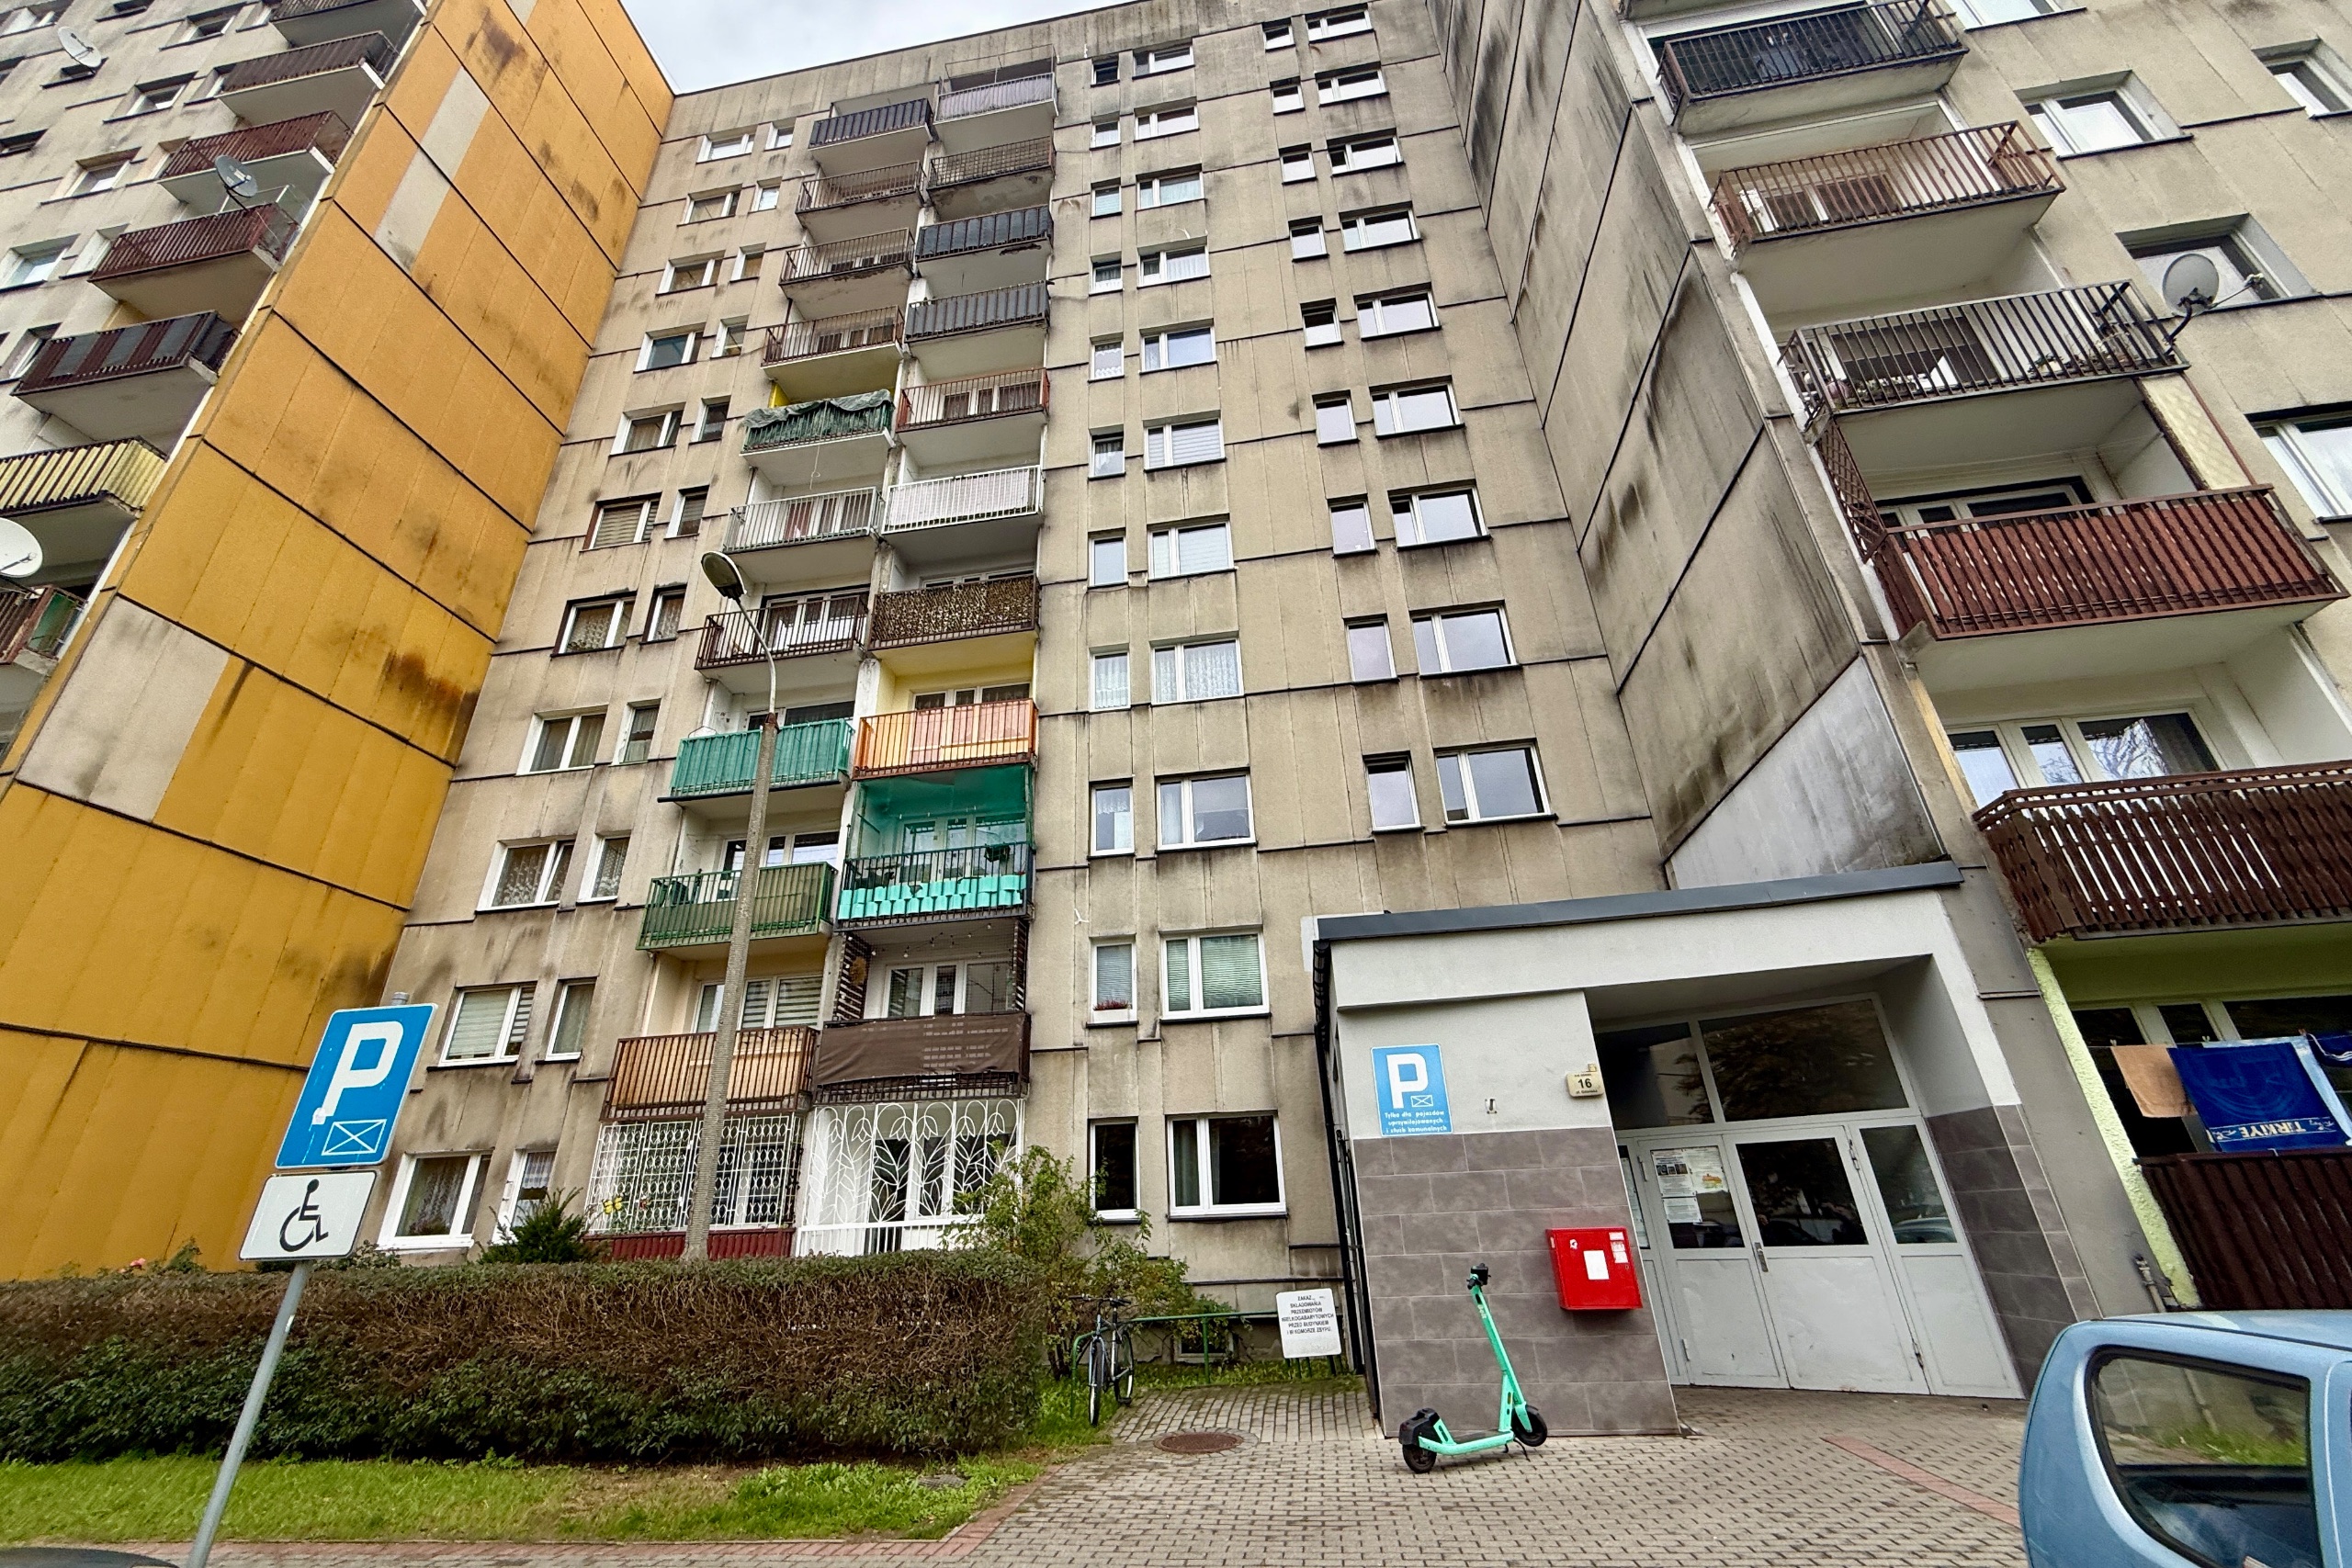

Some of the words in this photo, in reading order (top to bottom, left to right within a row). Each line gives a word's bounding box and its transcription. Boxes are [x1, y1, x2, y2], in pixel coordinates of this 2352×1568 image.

[322, 1021, 404, 1117] P
[1386, 1053, 1429, 1109] P
[1577, 1077, 1592, 1089] 16
